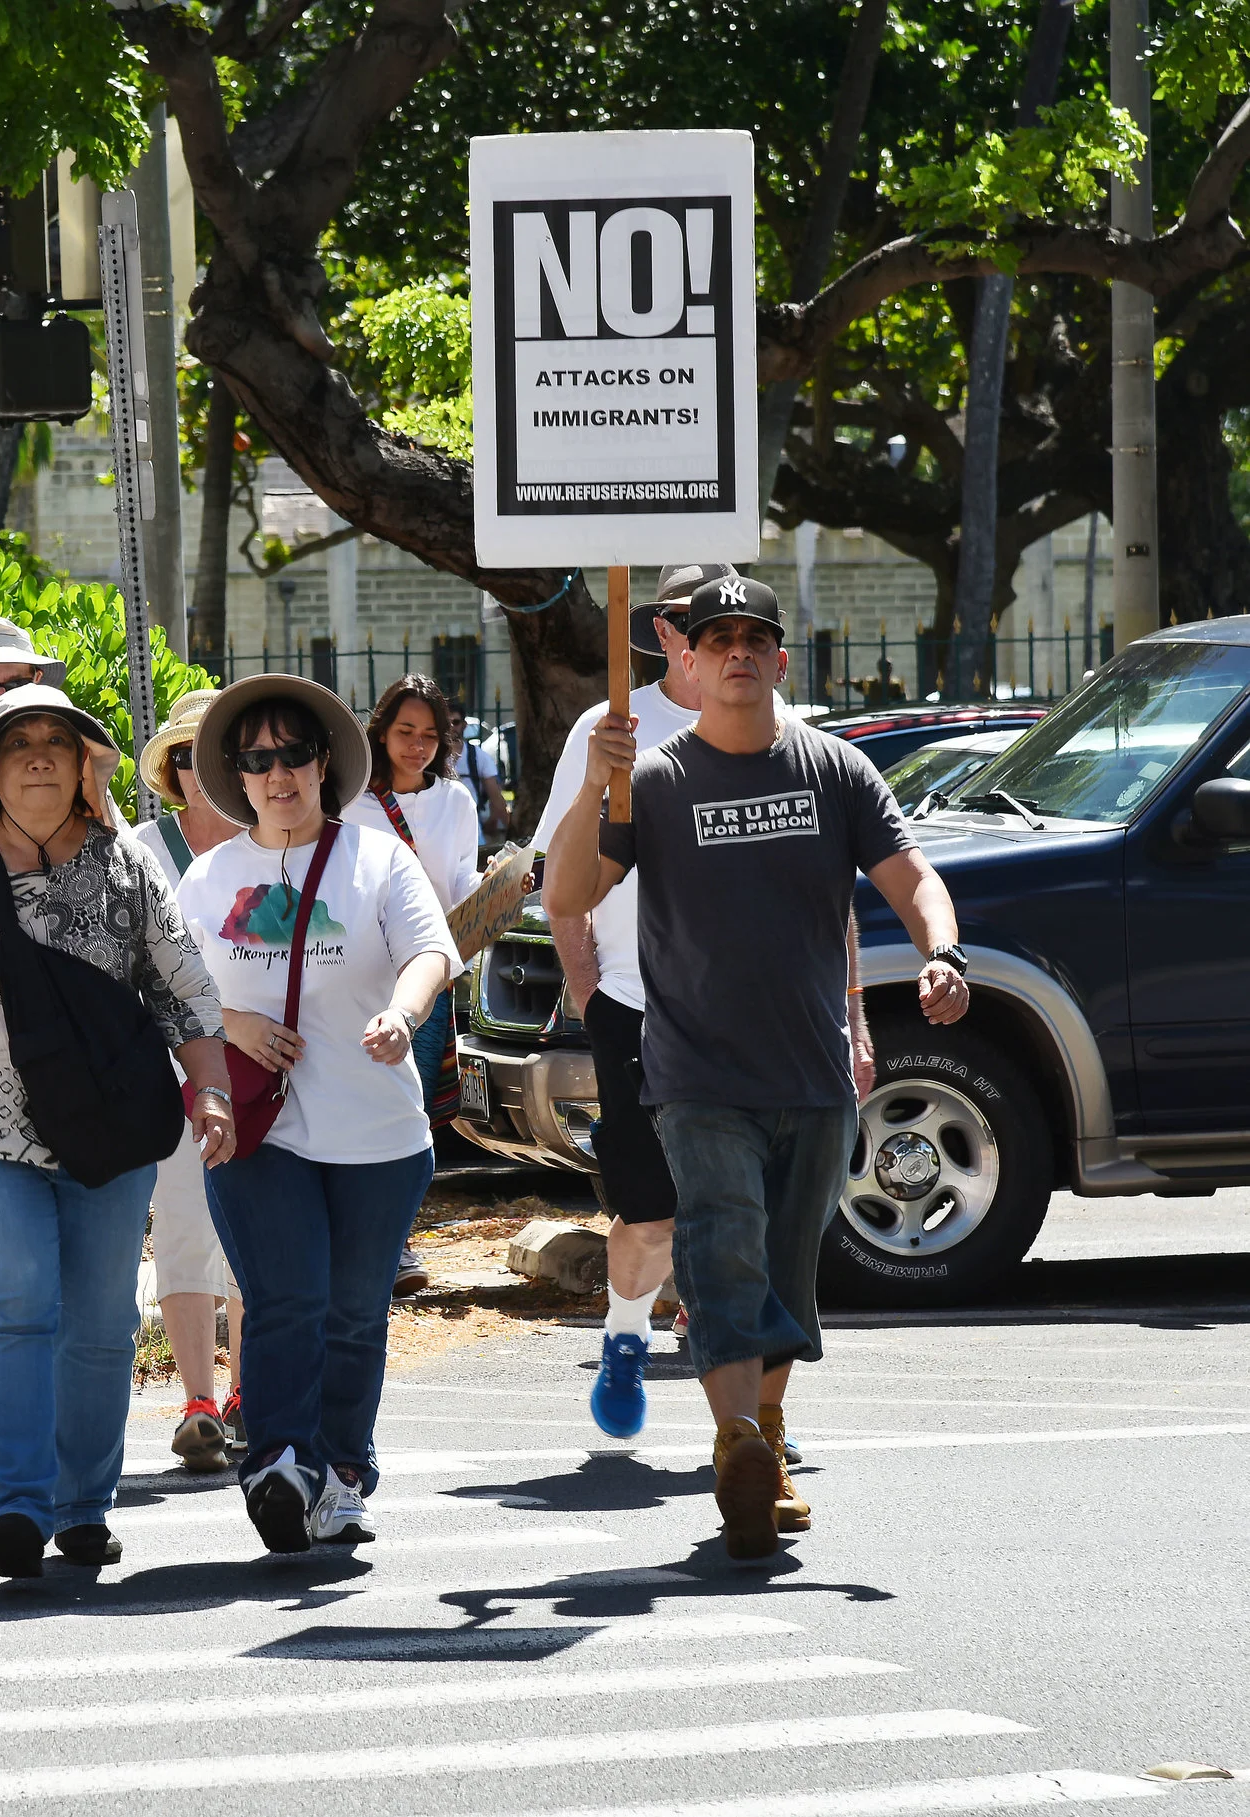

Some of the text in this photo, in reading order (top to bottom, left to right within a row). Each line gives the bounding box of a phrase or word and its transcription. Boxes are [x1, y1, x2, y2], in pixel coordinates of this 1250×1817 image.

[513, 206, 715, 338] NO!
[535, 368, 695, 387] ATTACKS ON
[533, 408, 699, 427] IMMIGRANTS!
[516, 481, 719, 503] WWW.REFUSEFASCISM.ORG
[718, 579, 747, 605] NY
[701, 799, 810, 825] TRUMP
[704, 815, 813, 837] FOR PRISON
[303, 940, 344, 968] gether
[886, 1055, 1001, 1100] VALERA HT
[840, 1235, 948, 1278] PRIMEWELL
